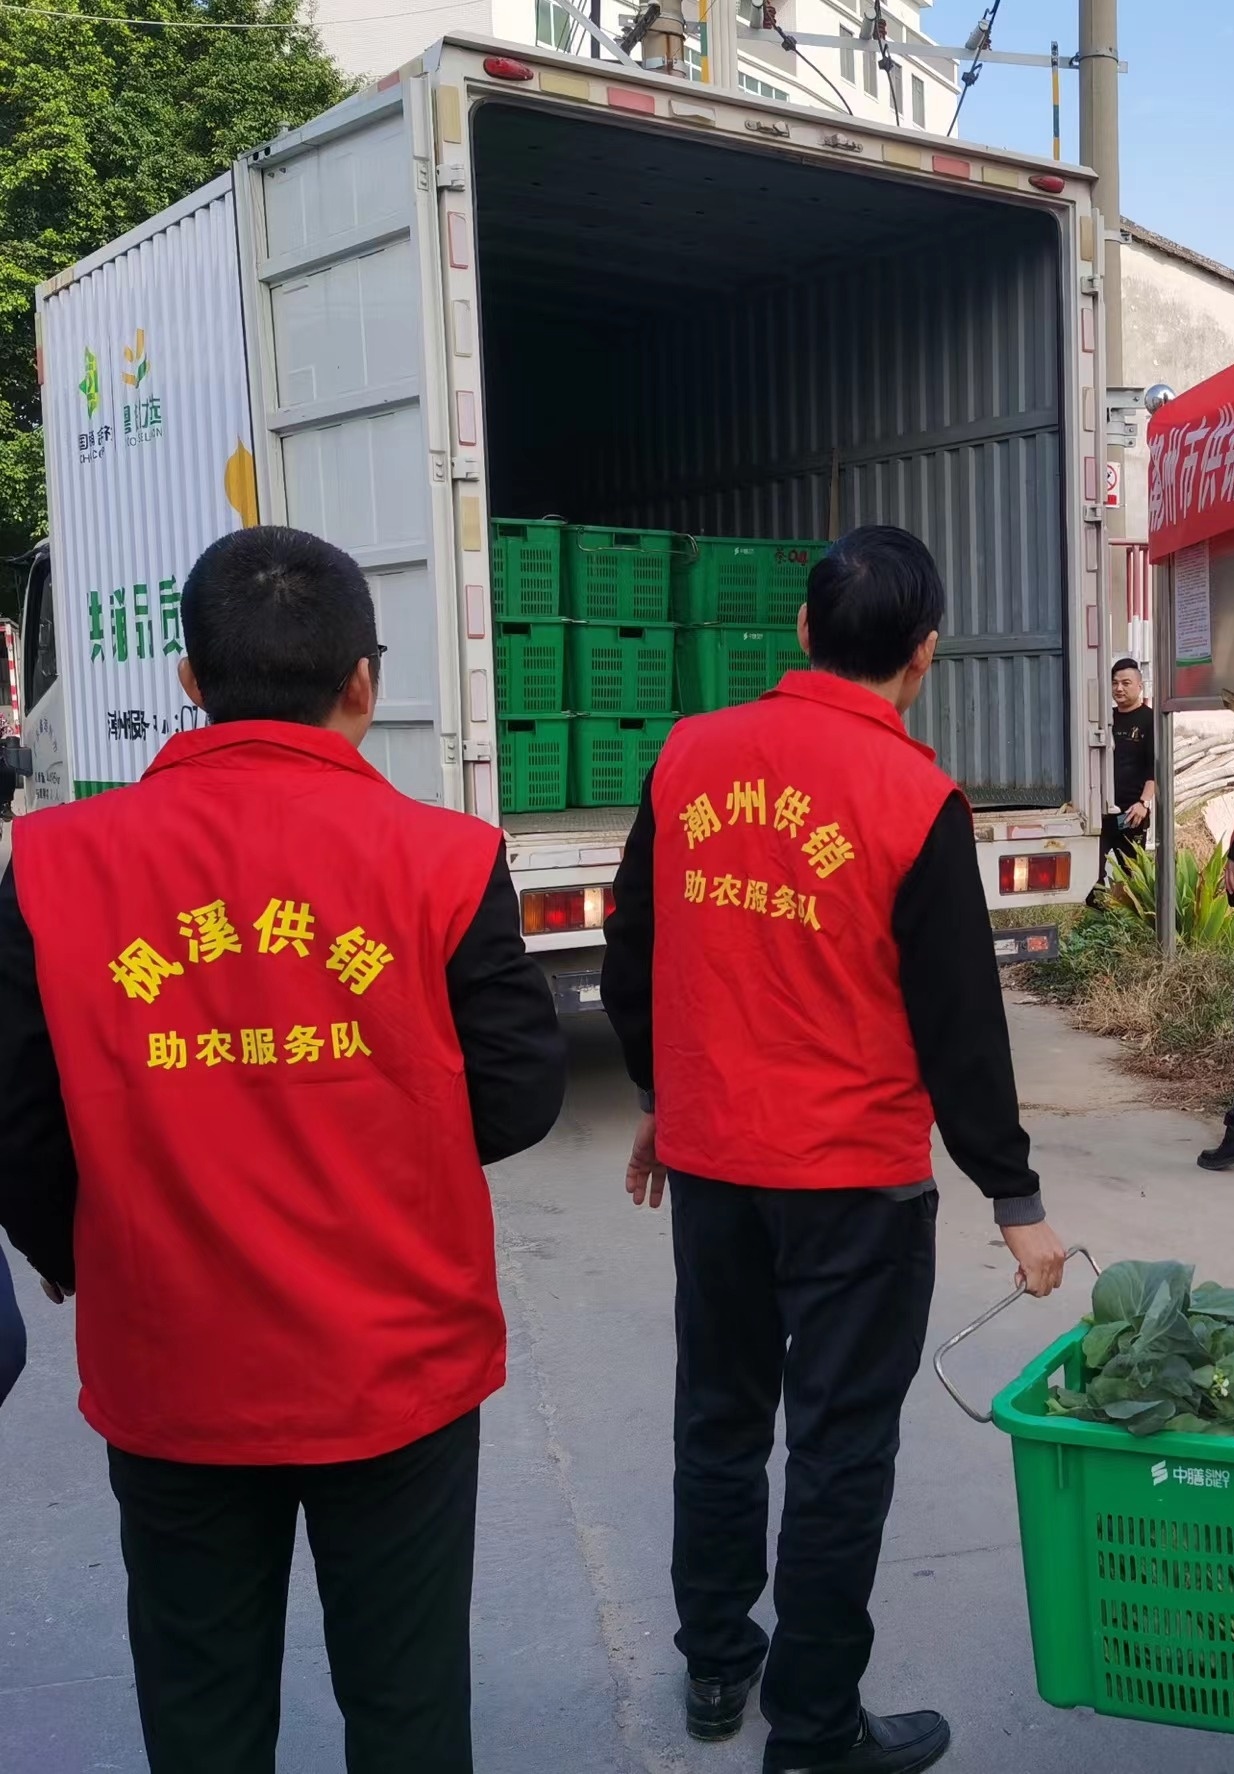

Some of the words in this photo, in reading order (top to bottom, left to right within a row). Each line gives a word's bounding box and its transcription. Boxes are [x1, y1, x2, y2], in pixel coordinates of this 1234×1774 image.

[679, 779, 855, 879] 潮州供销
[684, 870, 821, 931] 助农服务队
[108, 898, 394, 1004] 枫溪供销
[146, 1021, 372, 1070] 助农服务队
[1205, 1468, 1230, 1480] SINO
[1205, 1478, 1229, 1488] DIET
